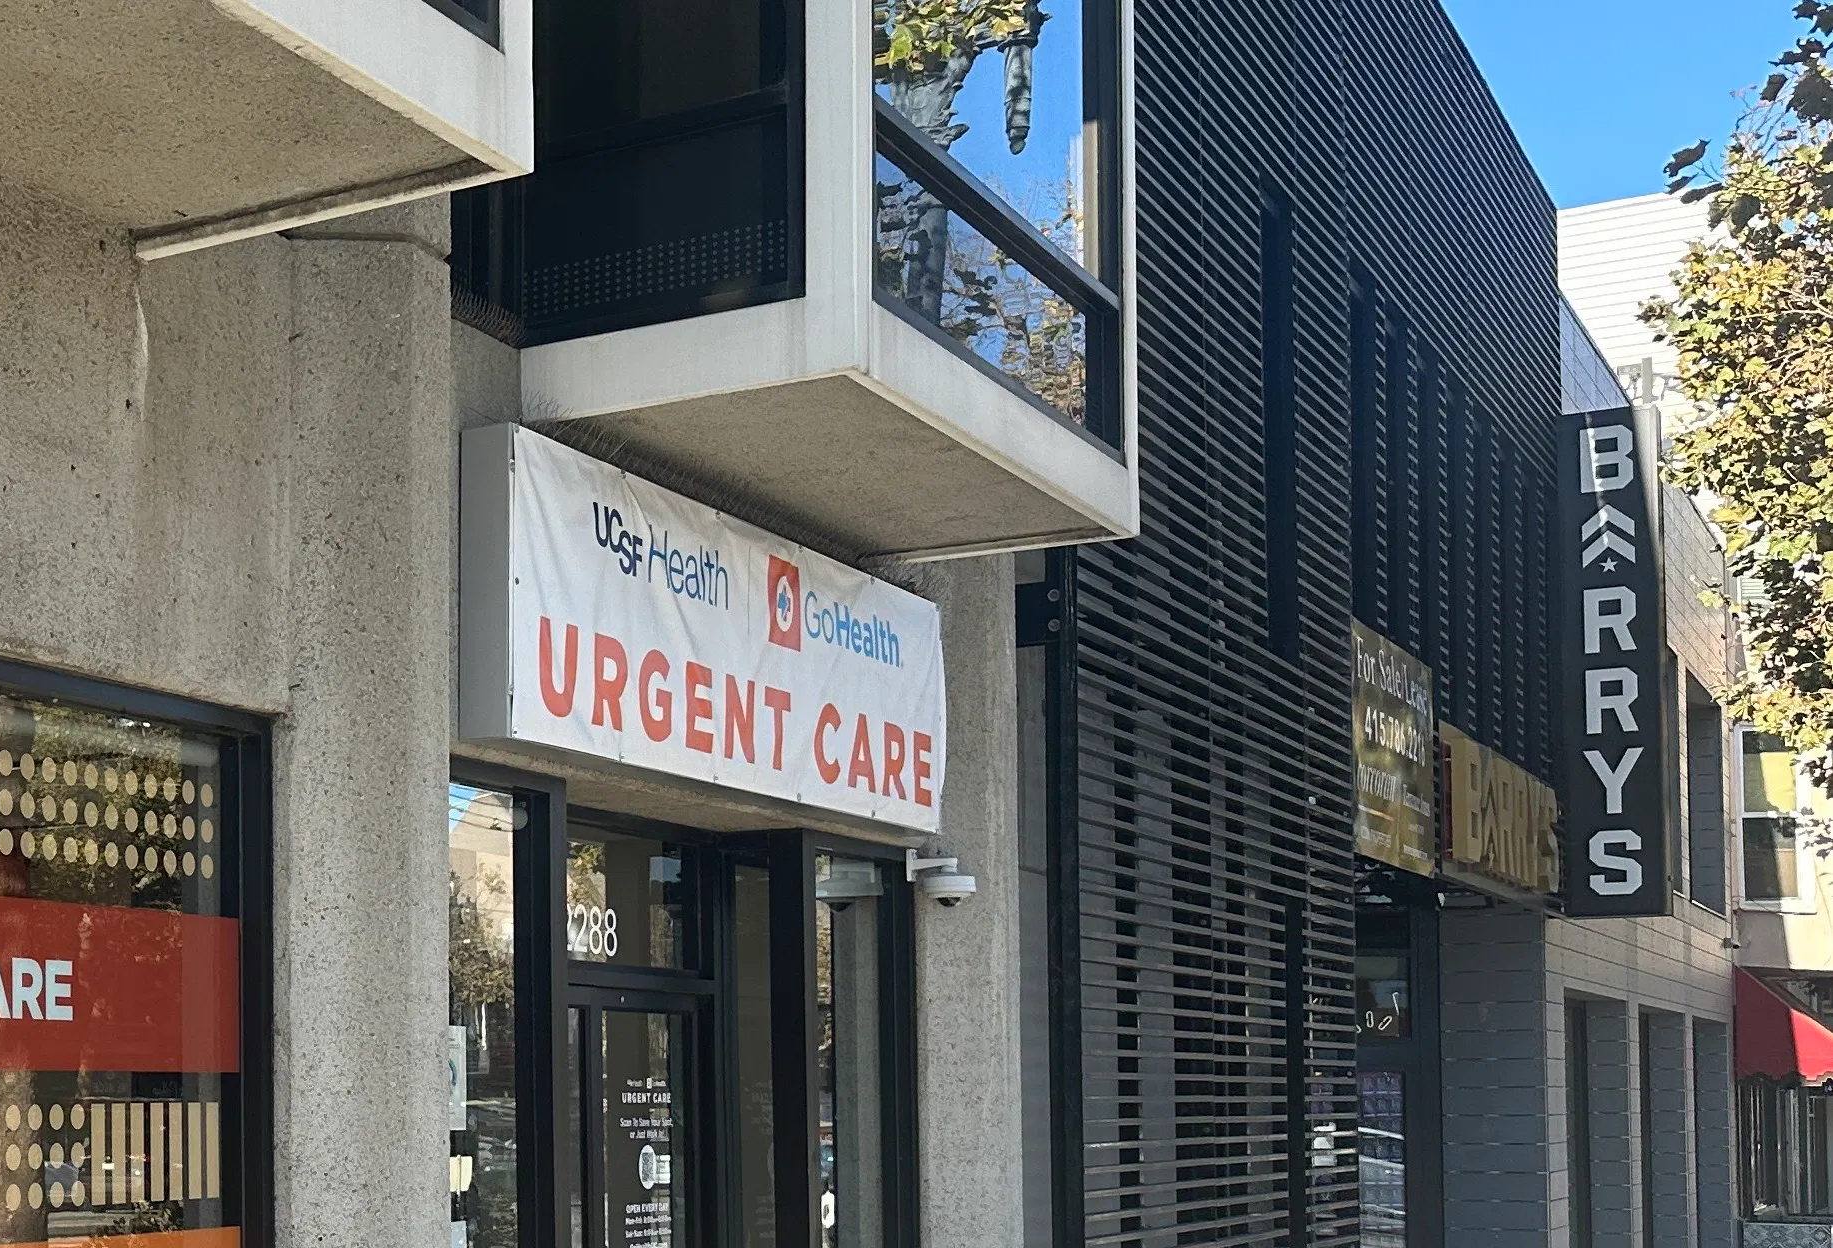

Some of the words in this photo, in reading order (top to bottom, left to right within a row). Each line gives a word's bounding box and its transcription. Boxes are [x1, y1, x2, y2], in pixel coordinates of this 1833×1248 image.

[592, 501, 643, 578] UCSF
[647, 523, 729, 610] Health
[804, 590, 901, 668] GoHealth
[1356, 636, 1376, 686] For
[538, 615, 791, 771] URGENT
[813, 702, 933, 808] CARE
[621, 1092, 651, 1104] URGENT
[652, 1092, 672, 1104] CARE
